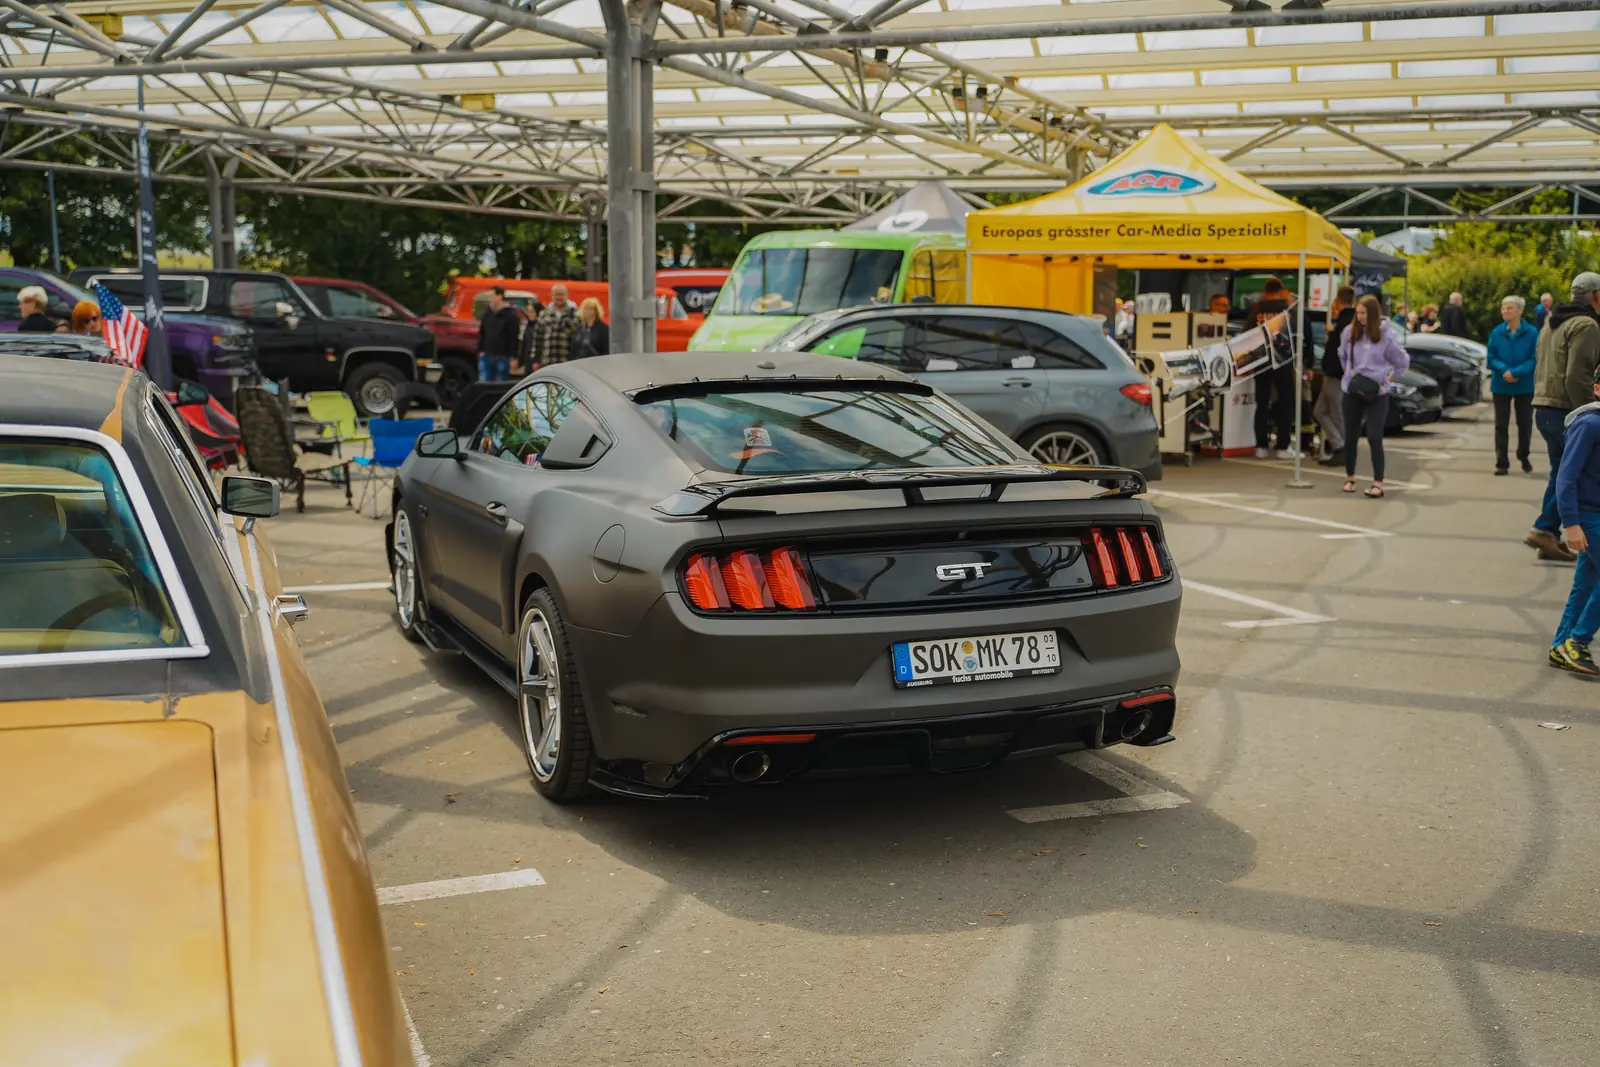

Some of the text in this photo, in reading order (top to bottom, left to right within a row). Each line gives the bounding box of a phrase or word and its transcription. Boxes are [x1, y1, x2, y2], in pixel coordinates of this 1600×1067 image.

[1102, 173, 1183, 193] ACR
[982, 223, 1288, 241] Europas grösster Car-Media Spezialist
[936, 562, 992, 580] GT
[1043, 634, 1054, 643] 03
[912, 635, 1041, 674] SOK MK 78
[1046, 653, 1057, 662] 10
[900, 665, 907, 675] D
[952, 670, 1014, 683] fuchs automobile
